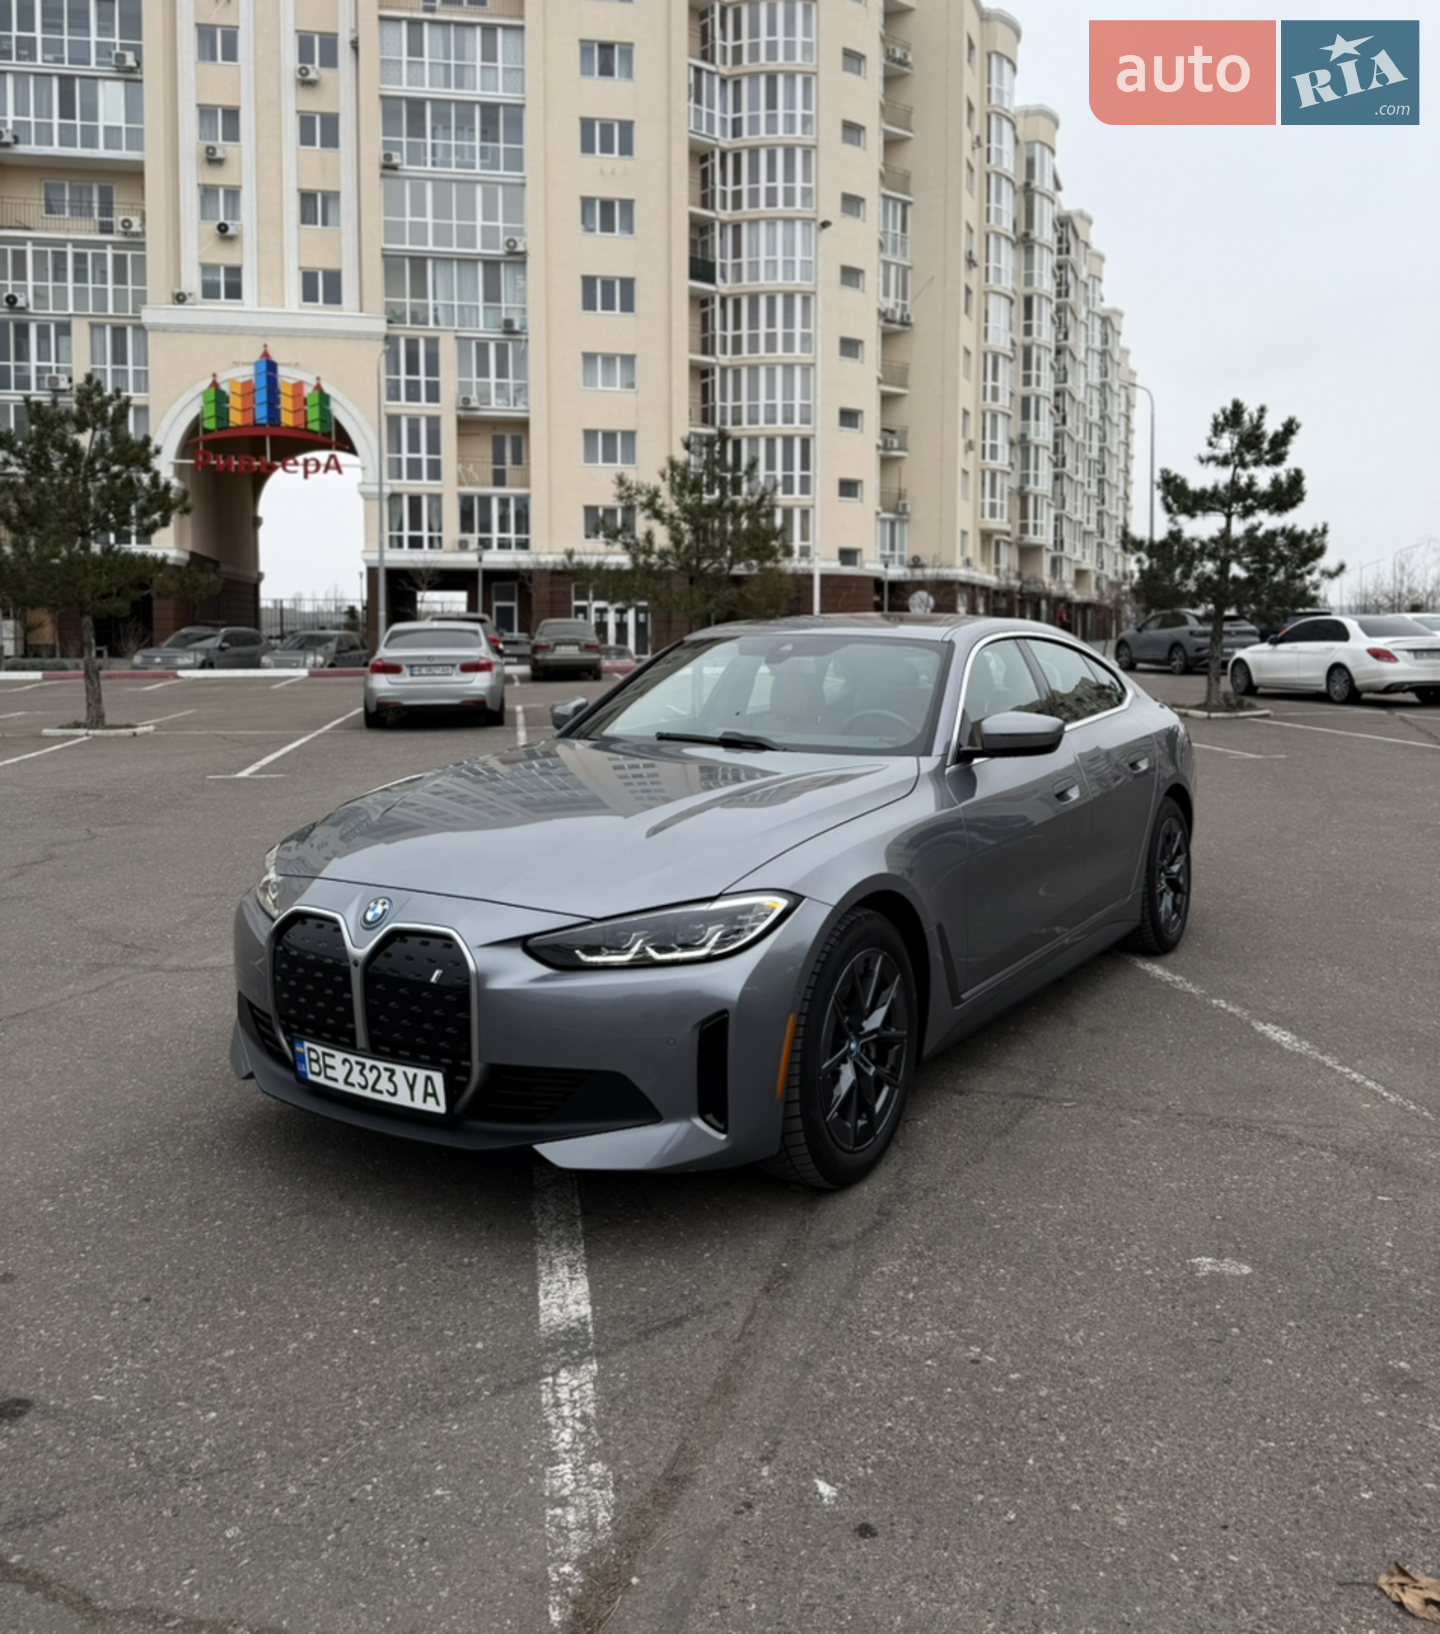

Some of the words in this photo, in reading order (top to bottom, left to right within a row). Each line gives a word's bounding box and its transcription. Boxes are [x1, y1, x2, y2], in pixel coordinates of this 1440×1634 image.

[307, 1046, 339, 1083] BE
[341, 1057, 398, 1097] 2323
[402, 1070, 441, 1107] YA
